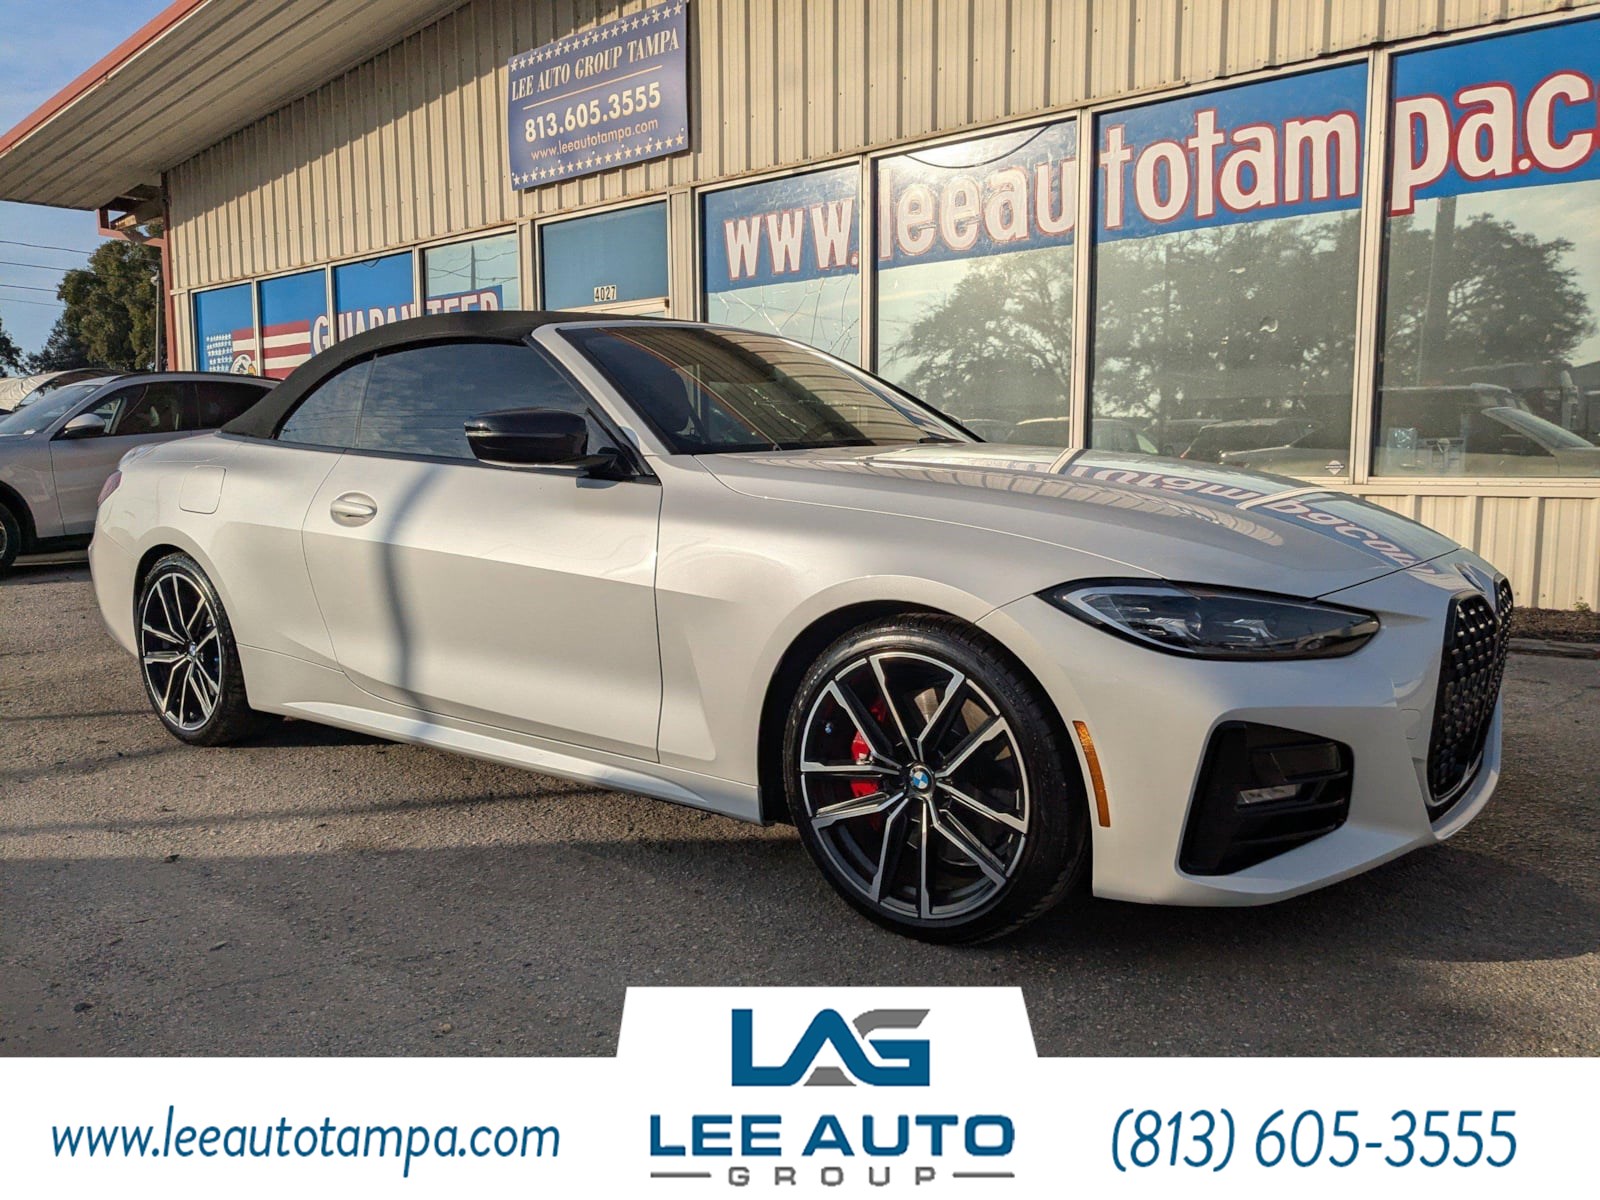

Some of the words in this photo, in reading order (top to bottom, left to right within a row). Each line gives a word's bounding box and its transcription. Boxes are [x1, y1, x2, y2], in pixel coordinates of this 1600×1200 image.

[512, 75, 534, 101] LEE
[537, 63, 571, 93] AUTO
[575, 46, 622, 80] GROUP
[627, 27, 680, 63] TAMPA
[525, 82, 661, 143] 813.605.3555
[531, 118, 659, 161] www.leeautotampa.com
[724, 69, 1600, 280] www.leeautotampa.c
[595, 286, 616, 301] 4027
